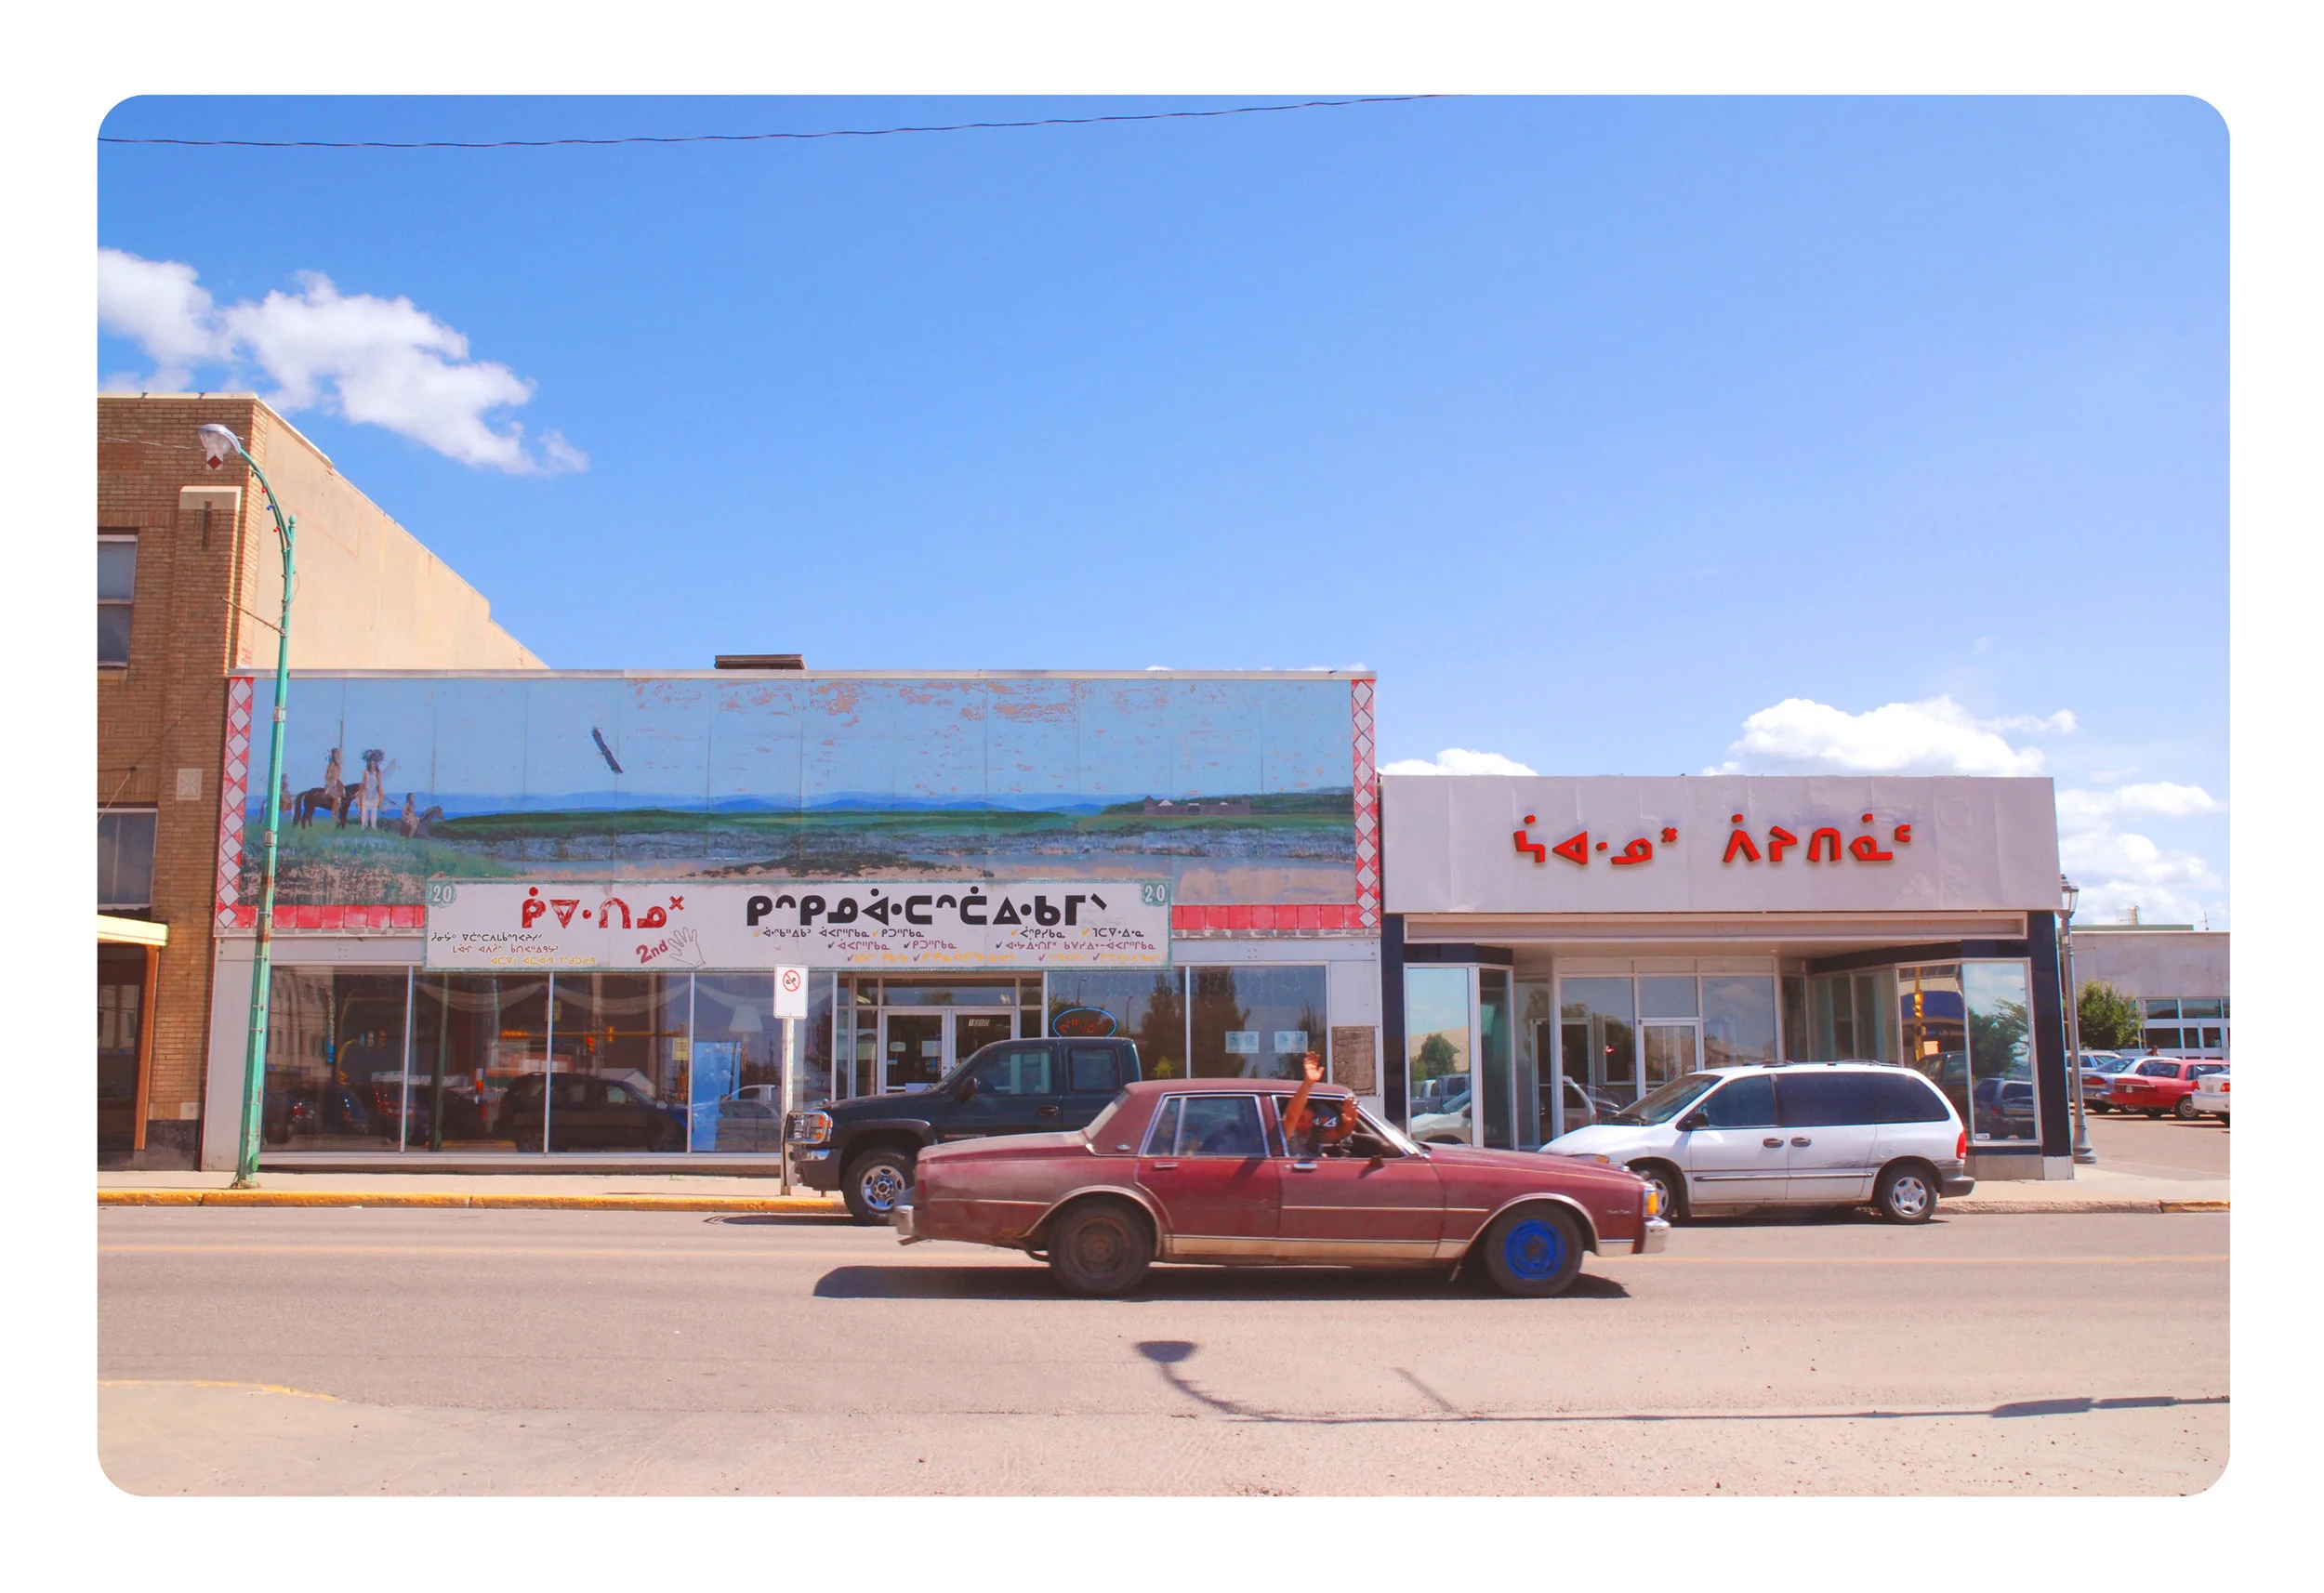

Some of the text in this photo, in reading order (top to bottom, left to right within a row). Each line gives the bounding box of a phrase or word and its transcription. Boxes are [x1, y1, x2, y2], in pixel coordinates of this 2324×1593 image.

[433, 885, 454, 902] 20
[1143, 885, 1167, 902] 20
[636, 939, 668, 964] 2nd
